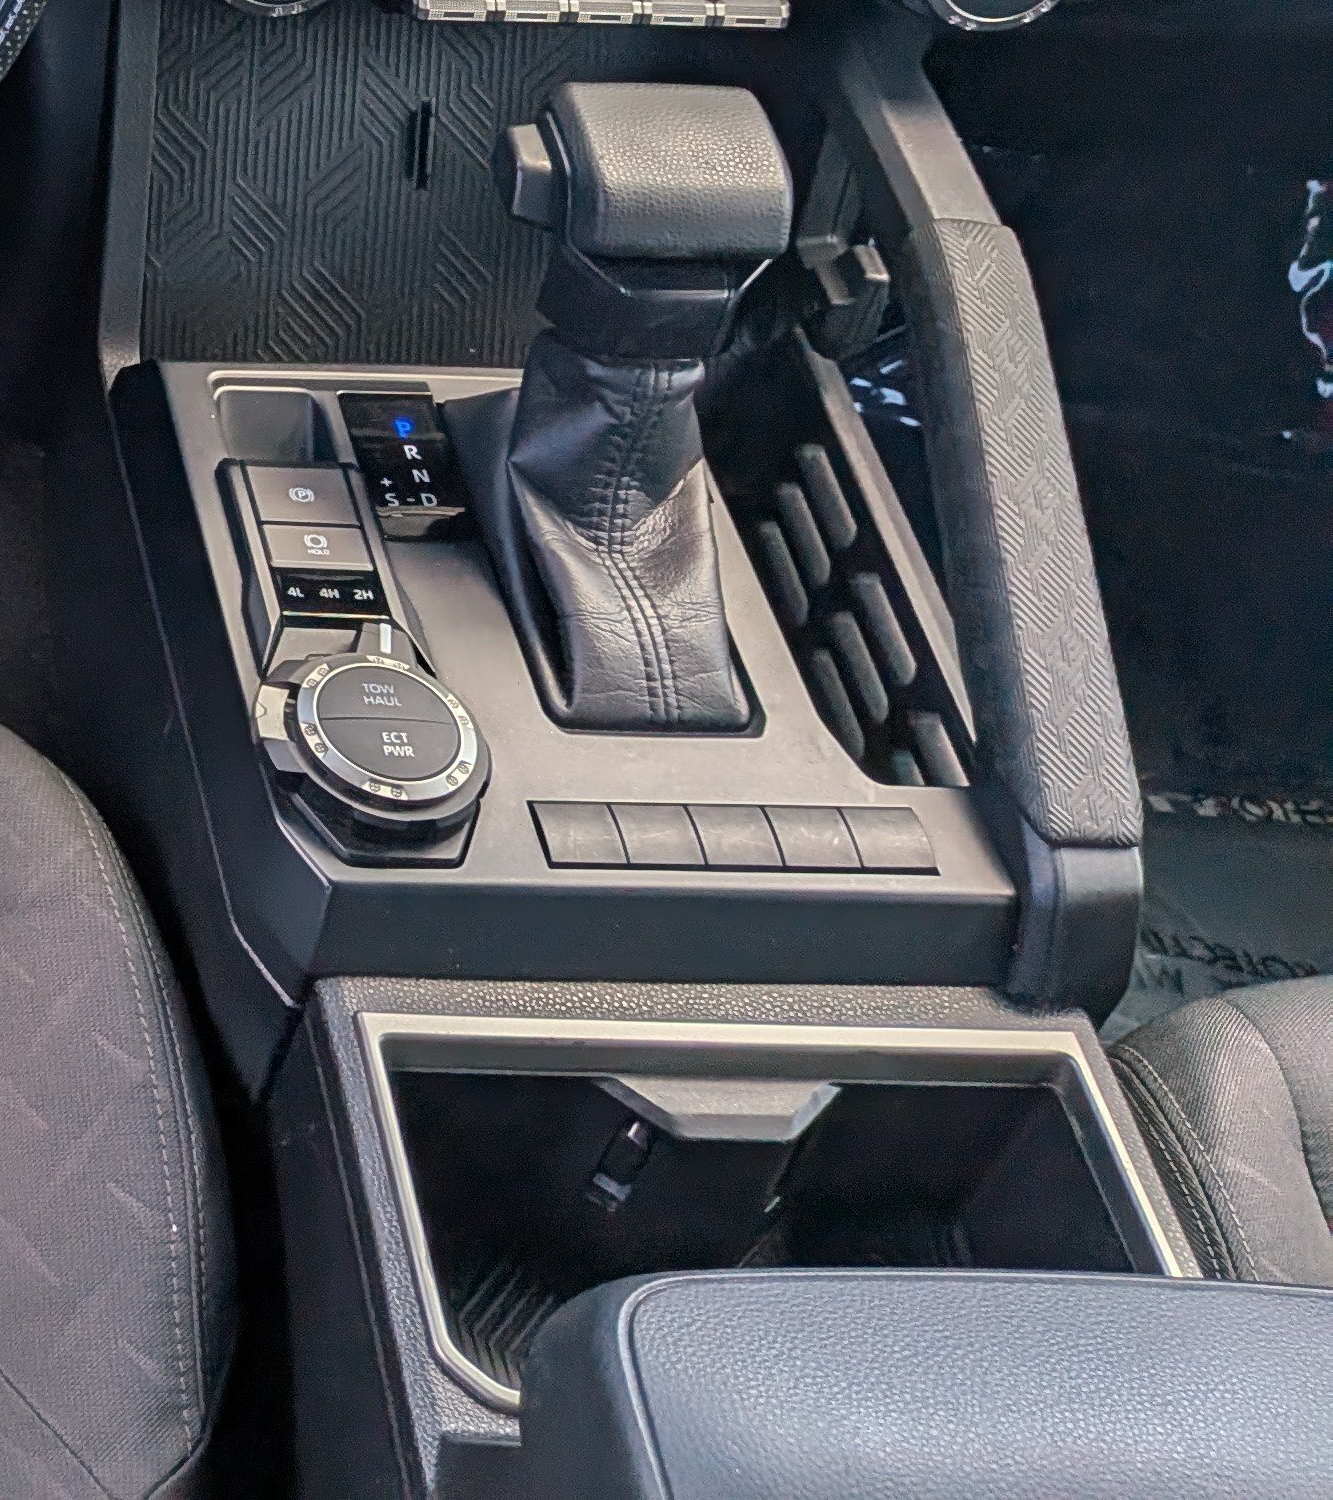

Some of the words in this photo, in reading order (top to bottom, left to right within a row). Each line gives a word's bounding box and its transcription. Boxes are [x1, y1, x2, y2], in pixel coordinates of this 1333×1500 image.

[403, 445, 422, 460] R
[412, 469, 431, 483] N
[385, 493, 400, 507] S
[421, 493, 437, 507] D
[307, 548, 331, 556] HOLD
[287, 586, 305, 598] 4L
[319, 587, 340, 600] 4H
[353, 588, 374, 601] 2H
[362, 683, 395, 694] TOW
[364, 695, 402, 707] HAUL
[382, 732, 408, 743] ECT
[382, 745, 415, 758] PWR
